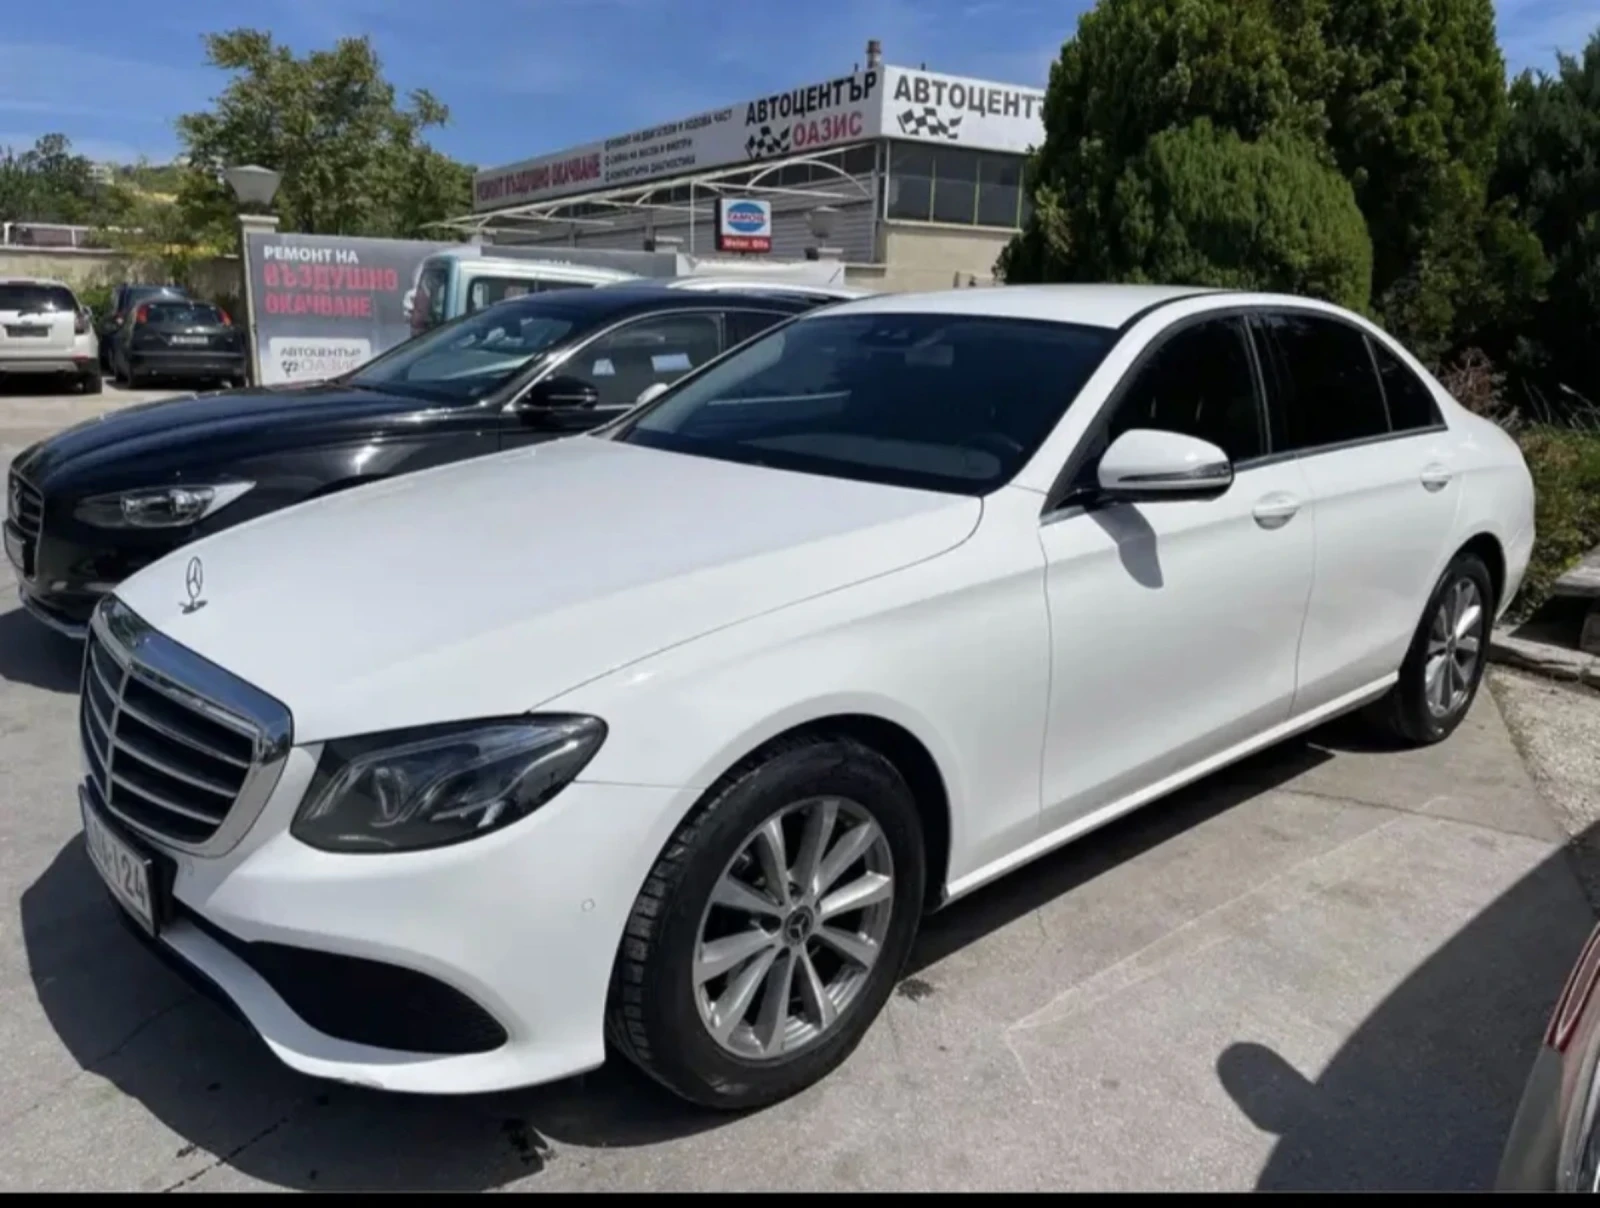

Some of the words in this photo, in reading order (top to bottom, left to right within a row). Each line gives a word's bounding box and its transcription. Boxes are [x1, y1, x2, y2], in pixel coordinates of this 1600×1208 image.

[745, 71, 877, 126] АВТОЦЕНТЪР
[792, 111, 863, 147] ОАЗИС
[263, 245, 332, 262] РЕМОНТ
[335, 249, 359, 264] НА
[263, 263, 398, 292] ВЪЗДУШНО
[265, 292, 371, 317] ОКАЧВАНЕ
